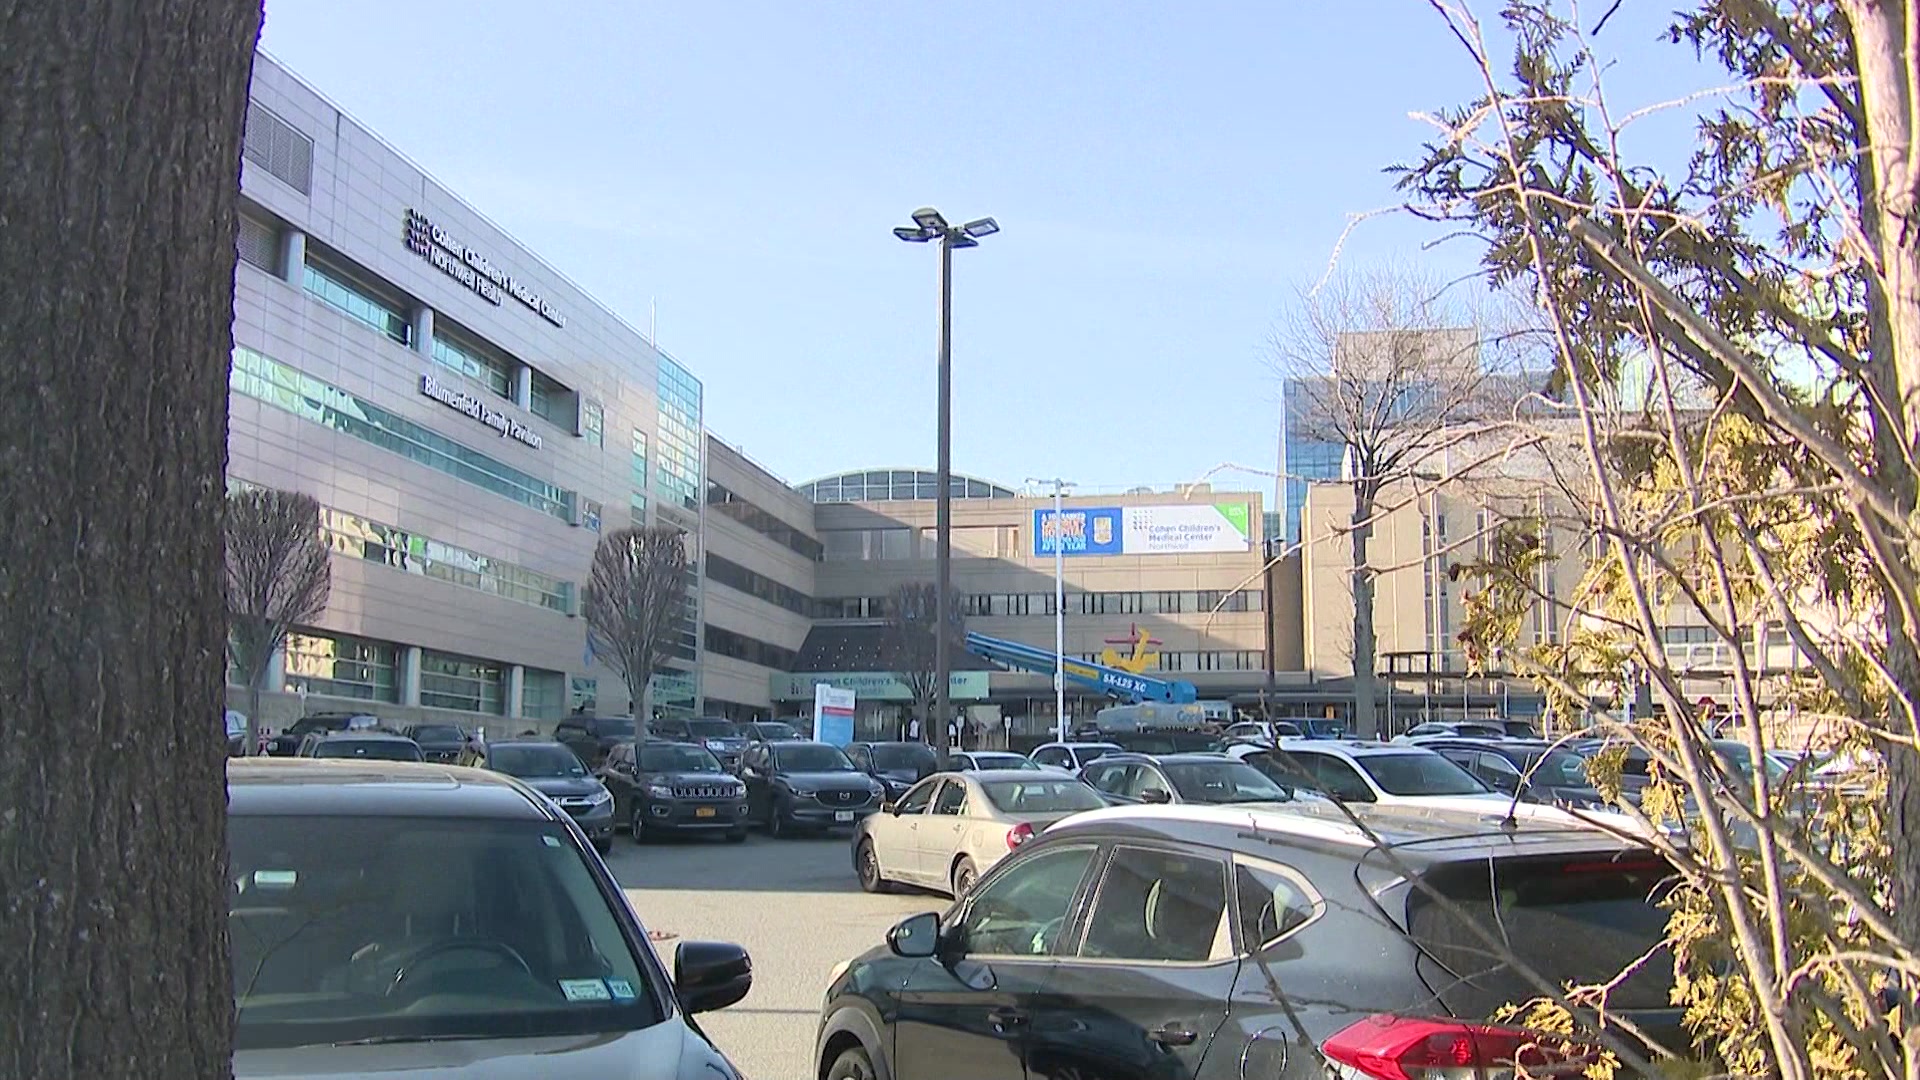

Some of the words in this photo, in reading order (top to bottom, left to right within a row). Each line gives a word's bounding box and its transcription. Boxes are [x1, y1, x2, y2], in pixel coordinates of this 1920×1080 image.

[431, 224, 463, 260] Cohen
[430, 245, 475, 291] Northwell
[424, 373, 480, 419] Blumenfeld
[480, 402, 511, 438] Family
[510, 418, 543, 451] Pavilion
[1148, 525, 1177, 533] Cohen
[1178, 523, 1221, 533] Children's
[1148, 533, 1182, 541] Medical
[1184, 533, 1213, 541] Center
[842, 676, 892, 687] Children's
[1103, 673, 1133, 690] SX-125
[1132, 680, 1147, 693] XC
